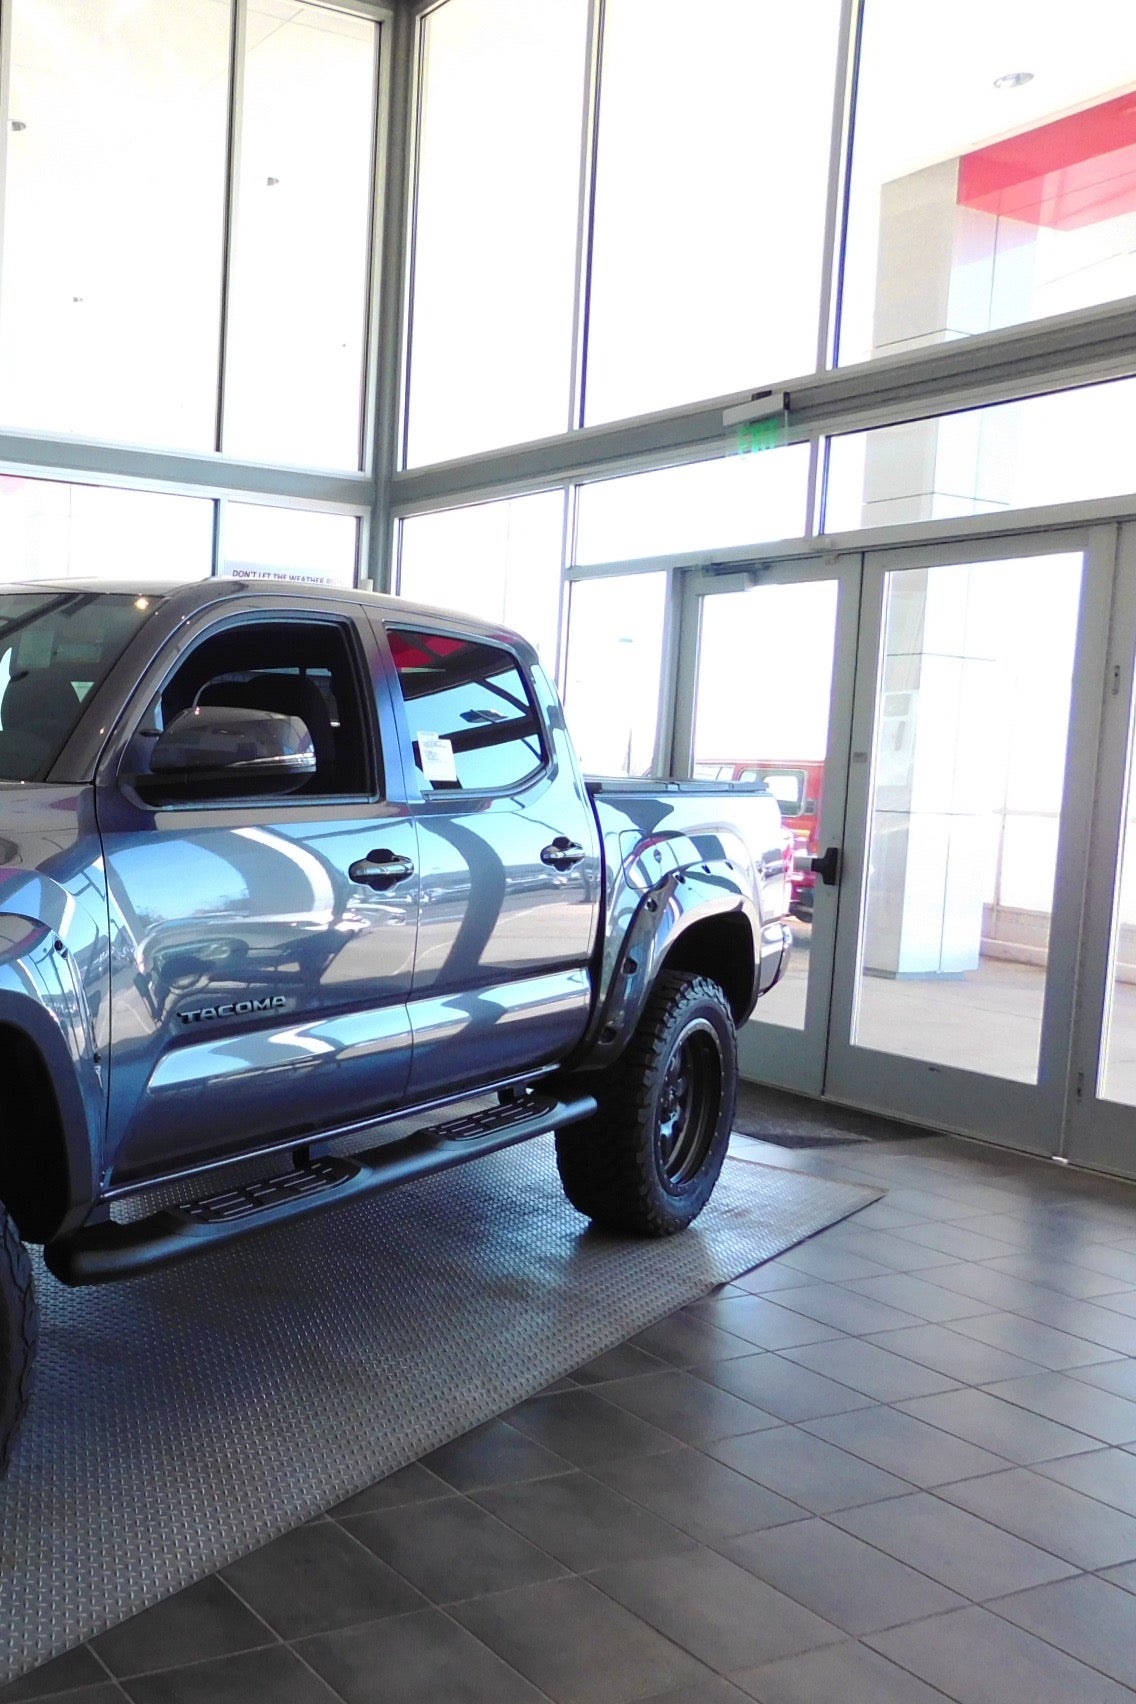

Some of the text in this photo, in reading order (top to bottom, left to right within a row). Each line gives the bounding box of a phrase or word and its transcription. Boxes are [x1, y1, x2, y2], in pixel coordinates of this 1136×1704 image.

[739, 417, 779, 455] EXIT
[232, 569, 257, 578] DON'T
[178, 996, 287, 1024] TACOMA
